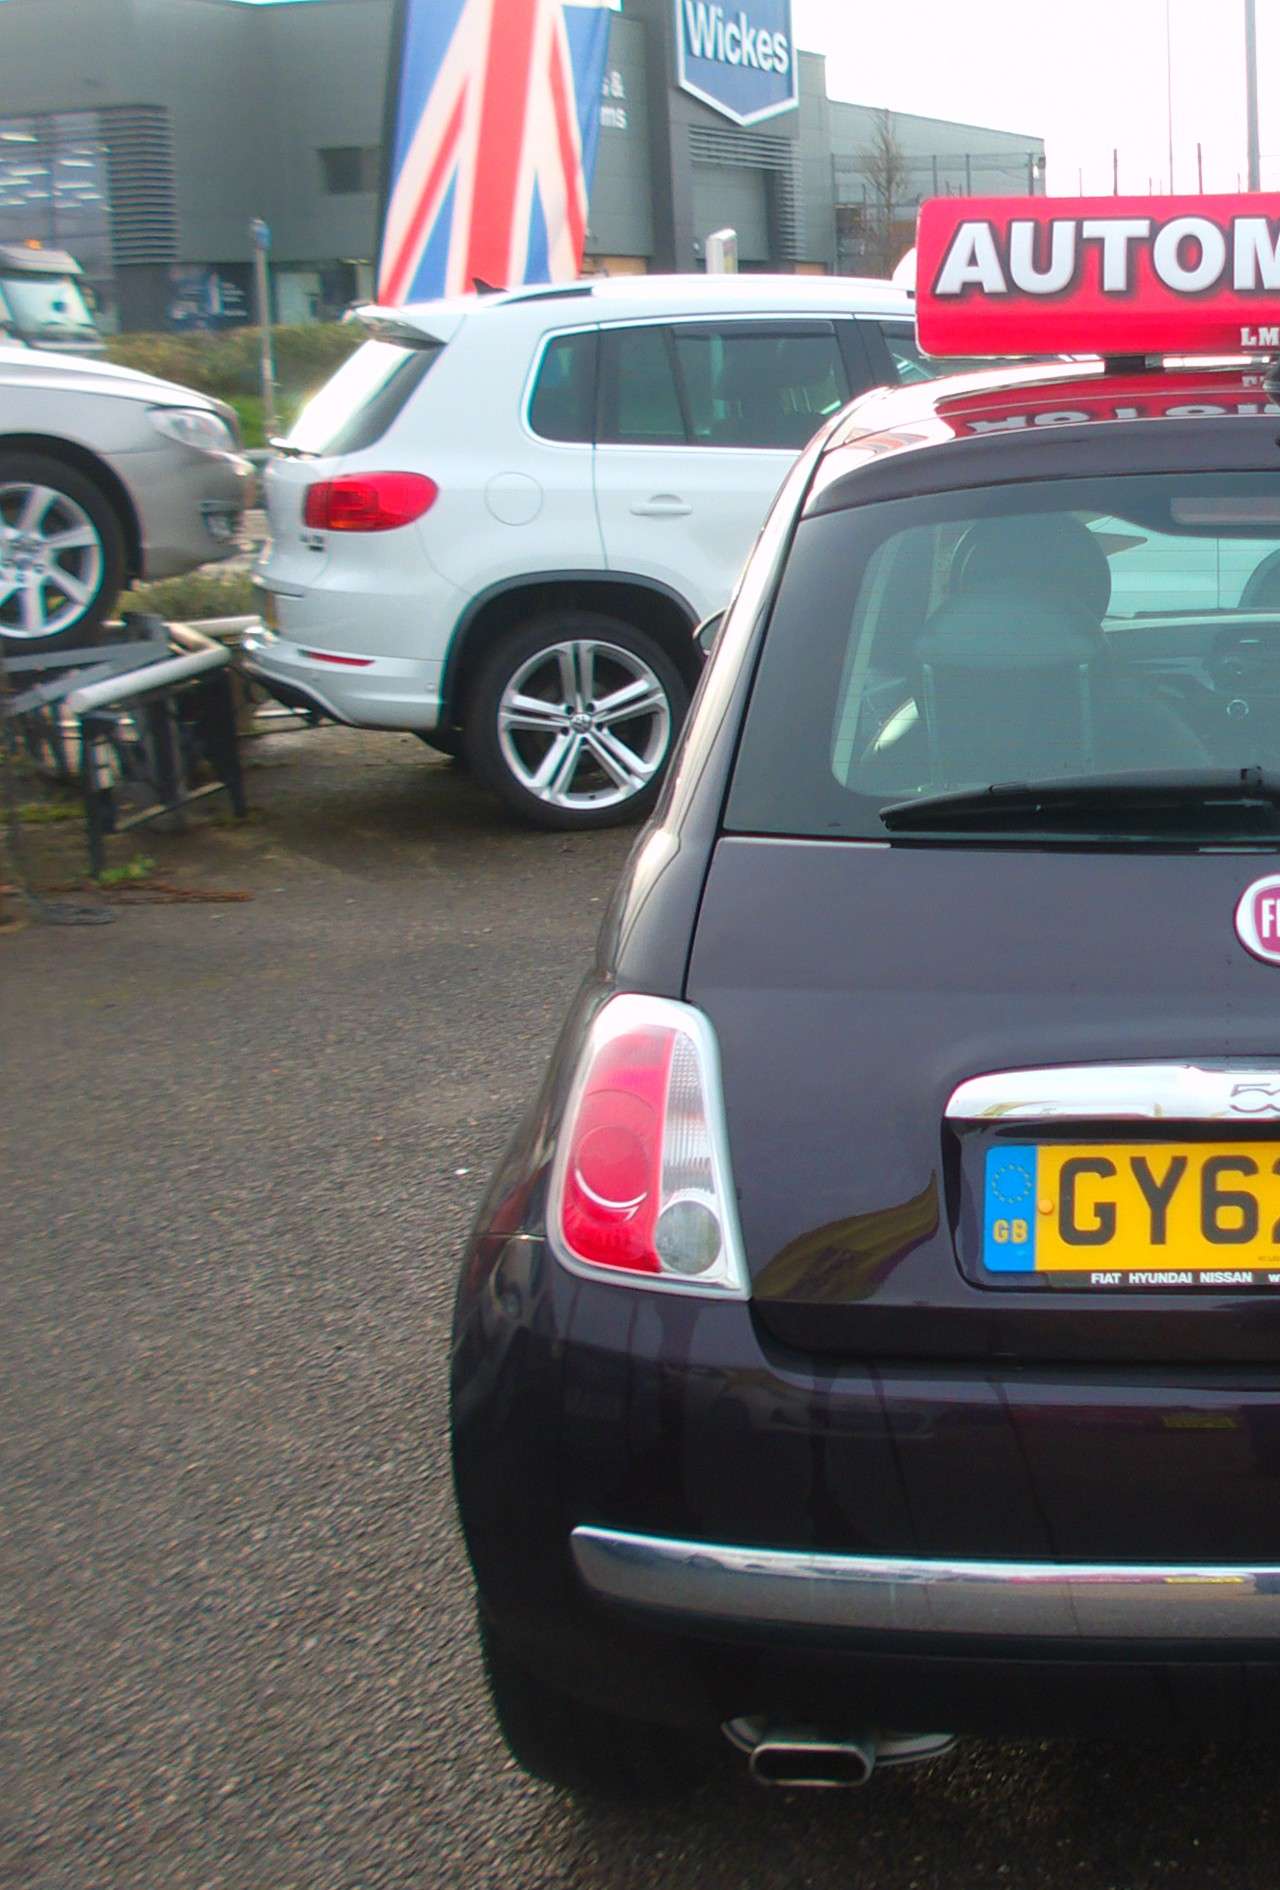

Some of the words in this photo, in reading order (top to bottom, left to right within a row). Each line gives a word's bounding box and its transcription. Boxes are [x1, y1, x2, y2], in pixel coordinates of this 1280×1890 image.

[685, 0, 789, 74] Wickes
[993, 1219, 1028, 1243] GB
[1091, 1273, 1122, 1284] FIAT
[1129, 1272, 1192, 1284] HYUNDAI
[1200, 1271, 1253, 1283] NISSAN
